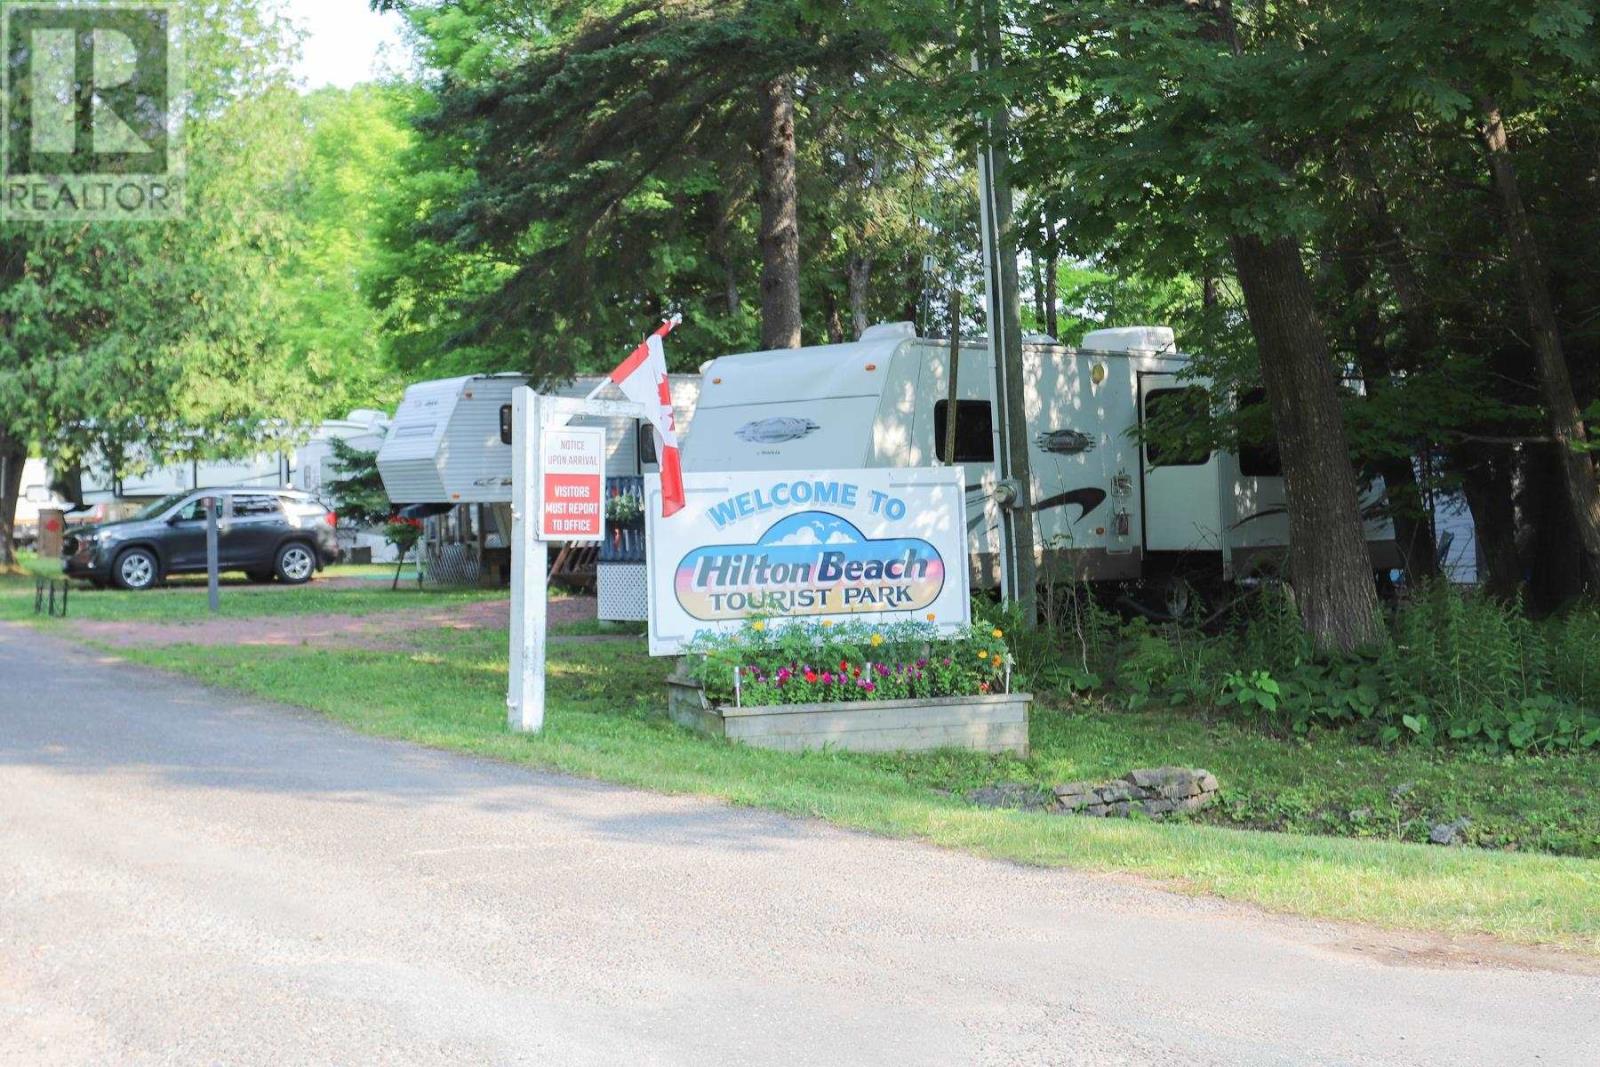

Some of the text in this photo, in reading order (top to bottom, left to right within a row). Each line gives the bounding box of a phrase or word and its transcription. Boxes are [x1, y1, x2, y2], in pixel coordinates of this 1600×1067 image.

[560, 440, 585, 450] NOTICE
[548, 455, 598, 465] UPON ARRIVAL
[554, 485, 590, 498] VISITORS
[545, 502, 598, 515] MUST REPORT
[706, 481, 907, 529] WELCOME TO
[552, 520, 591, 531] TO OFFICE
[692, 548, 928, 590] Hilton Beach
[709, 585, 914, 613] TOURIST PARK
